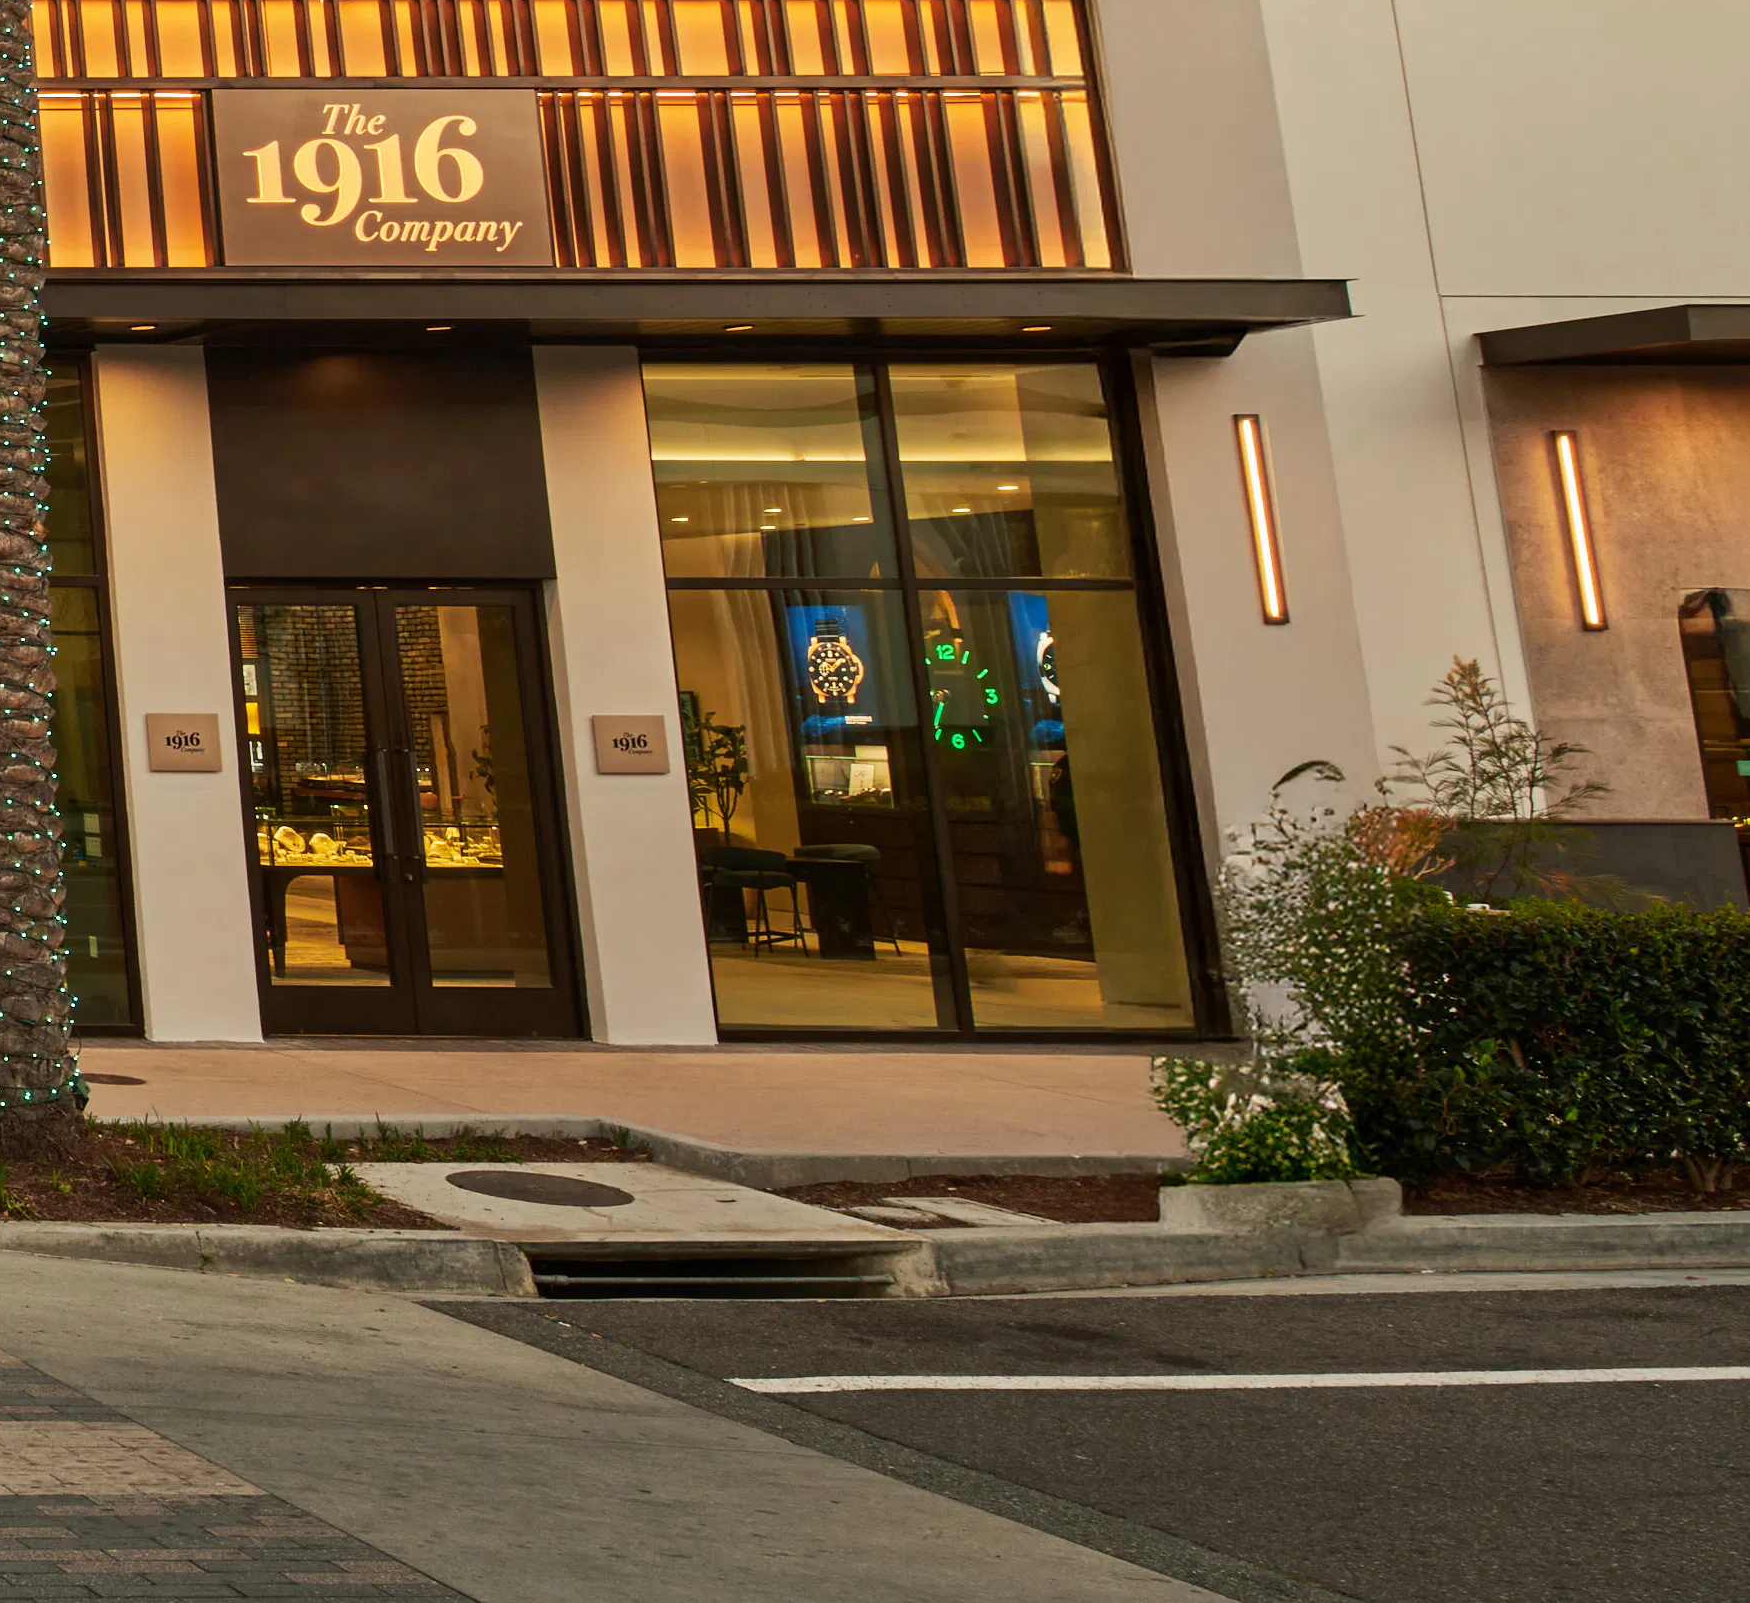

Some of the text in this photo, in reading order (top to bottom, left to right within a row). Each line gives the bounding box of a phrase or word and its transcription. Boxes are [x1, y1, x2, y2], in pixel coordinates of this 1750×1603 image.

[321, 102, 387, 135] The
[242, 114, 485, 227] 1916
[354, 209, 523, 252] Company
[936, 644, 955, 660] 12
[985, 688, 998, 704] 3
[165, 732, 201, 750] 1916
[612, 734, 648, 752] 1916
[951, 733, 965, 749] 6
[180, 747, 205, 755] Company
